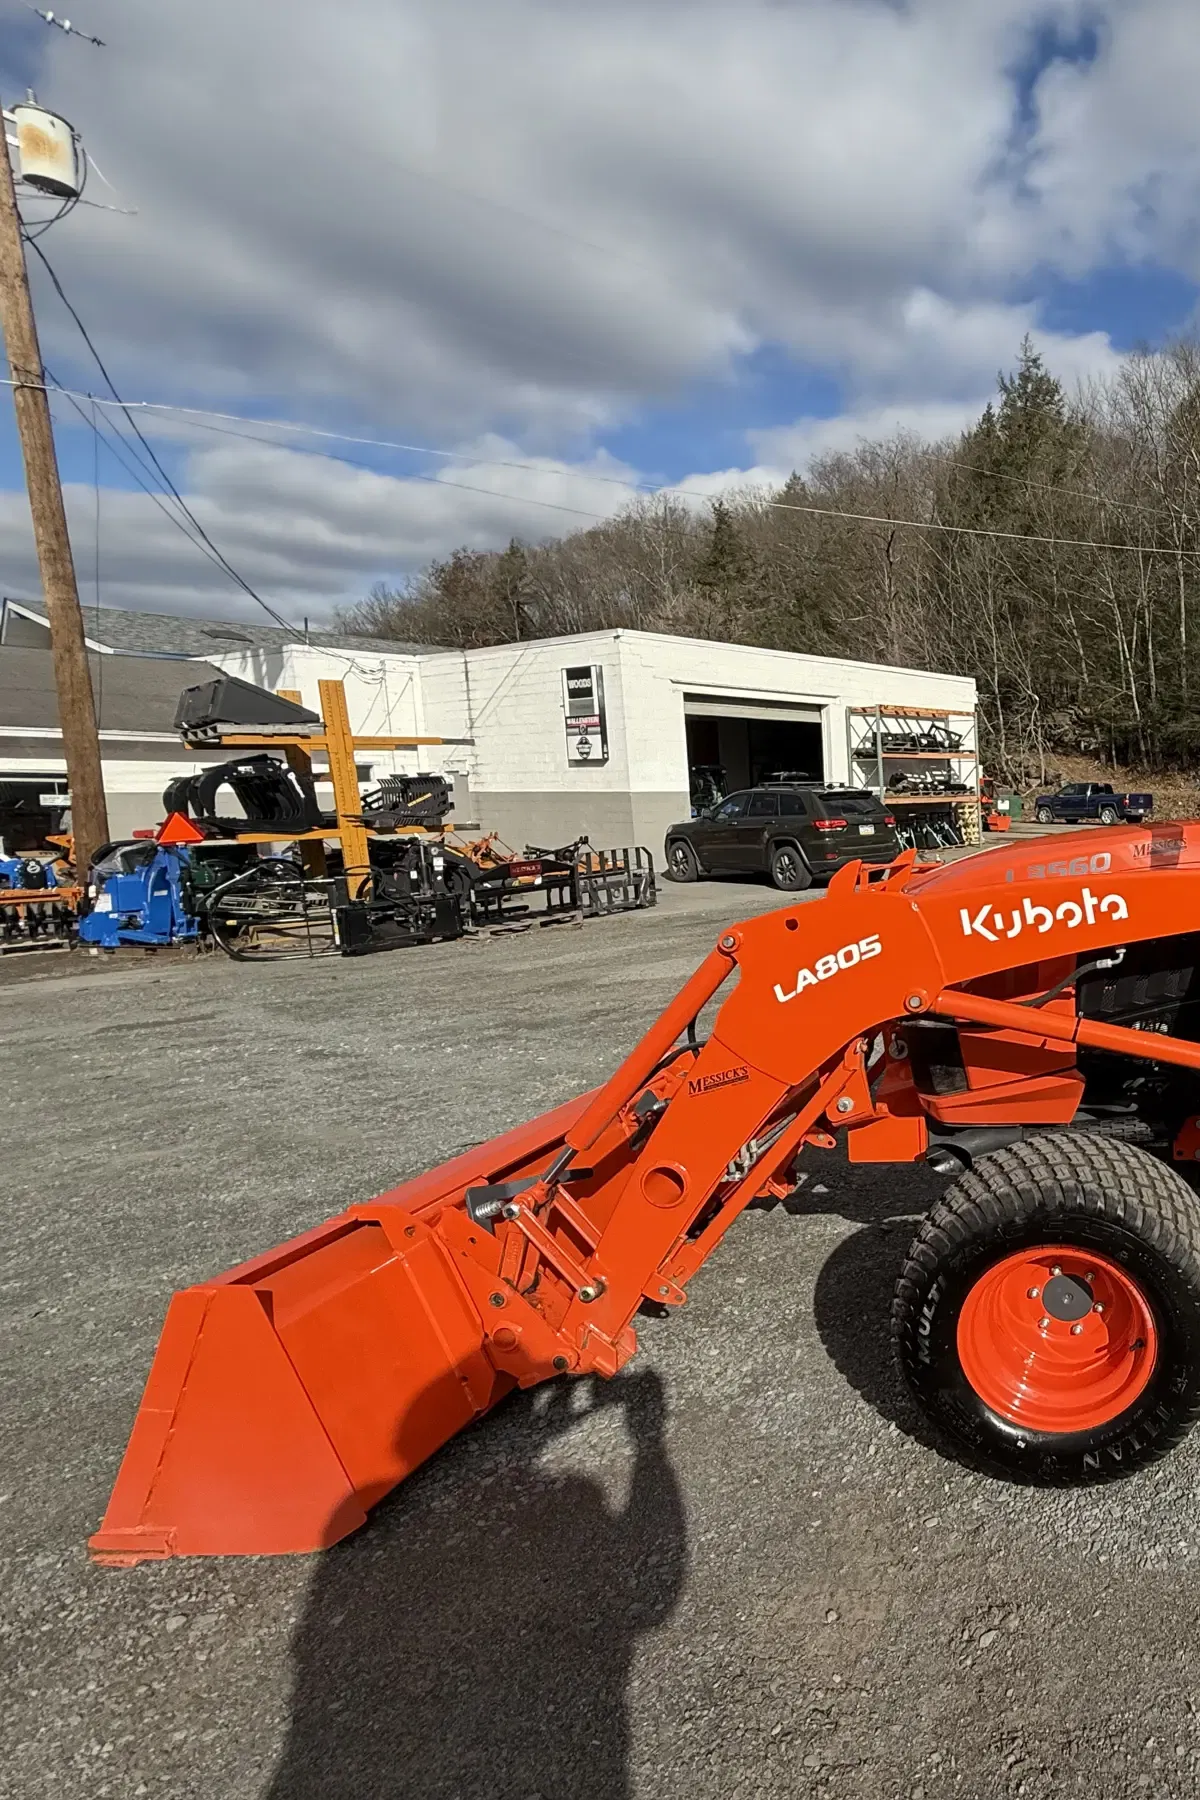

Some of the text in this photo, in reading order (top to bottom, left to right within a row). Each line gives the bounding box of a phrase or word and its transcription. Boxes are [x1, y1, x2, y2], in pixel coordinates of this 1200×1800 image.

[567, 679, 592, 689] WOODS
[959, 887, 1129, 942] Kubota
[773, 933, 882, 1003] LA805
[688, 1065, 750, 1096] MESSICK'S
[918, 1272, 947, 1365] MULTI
